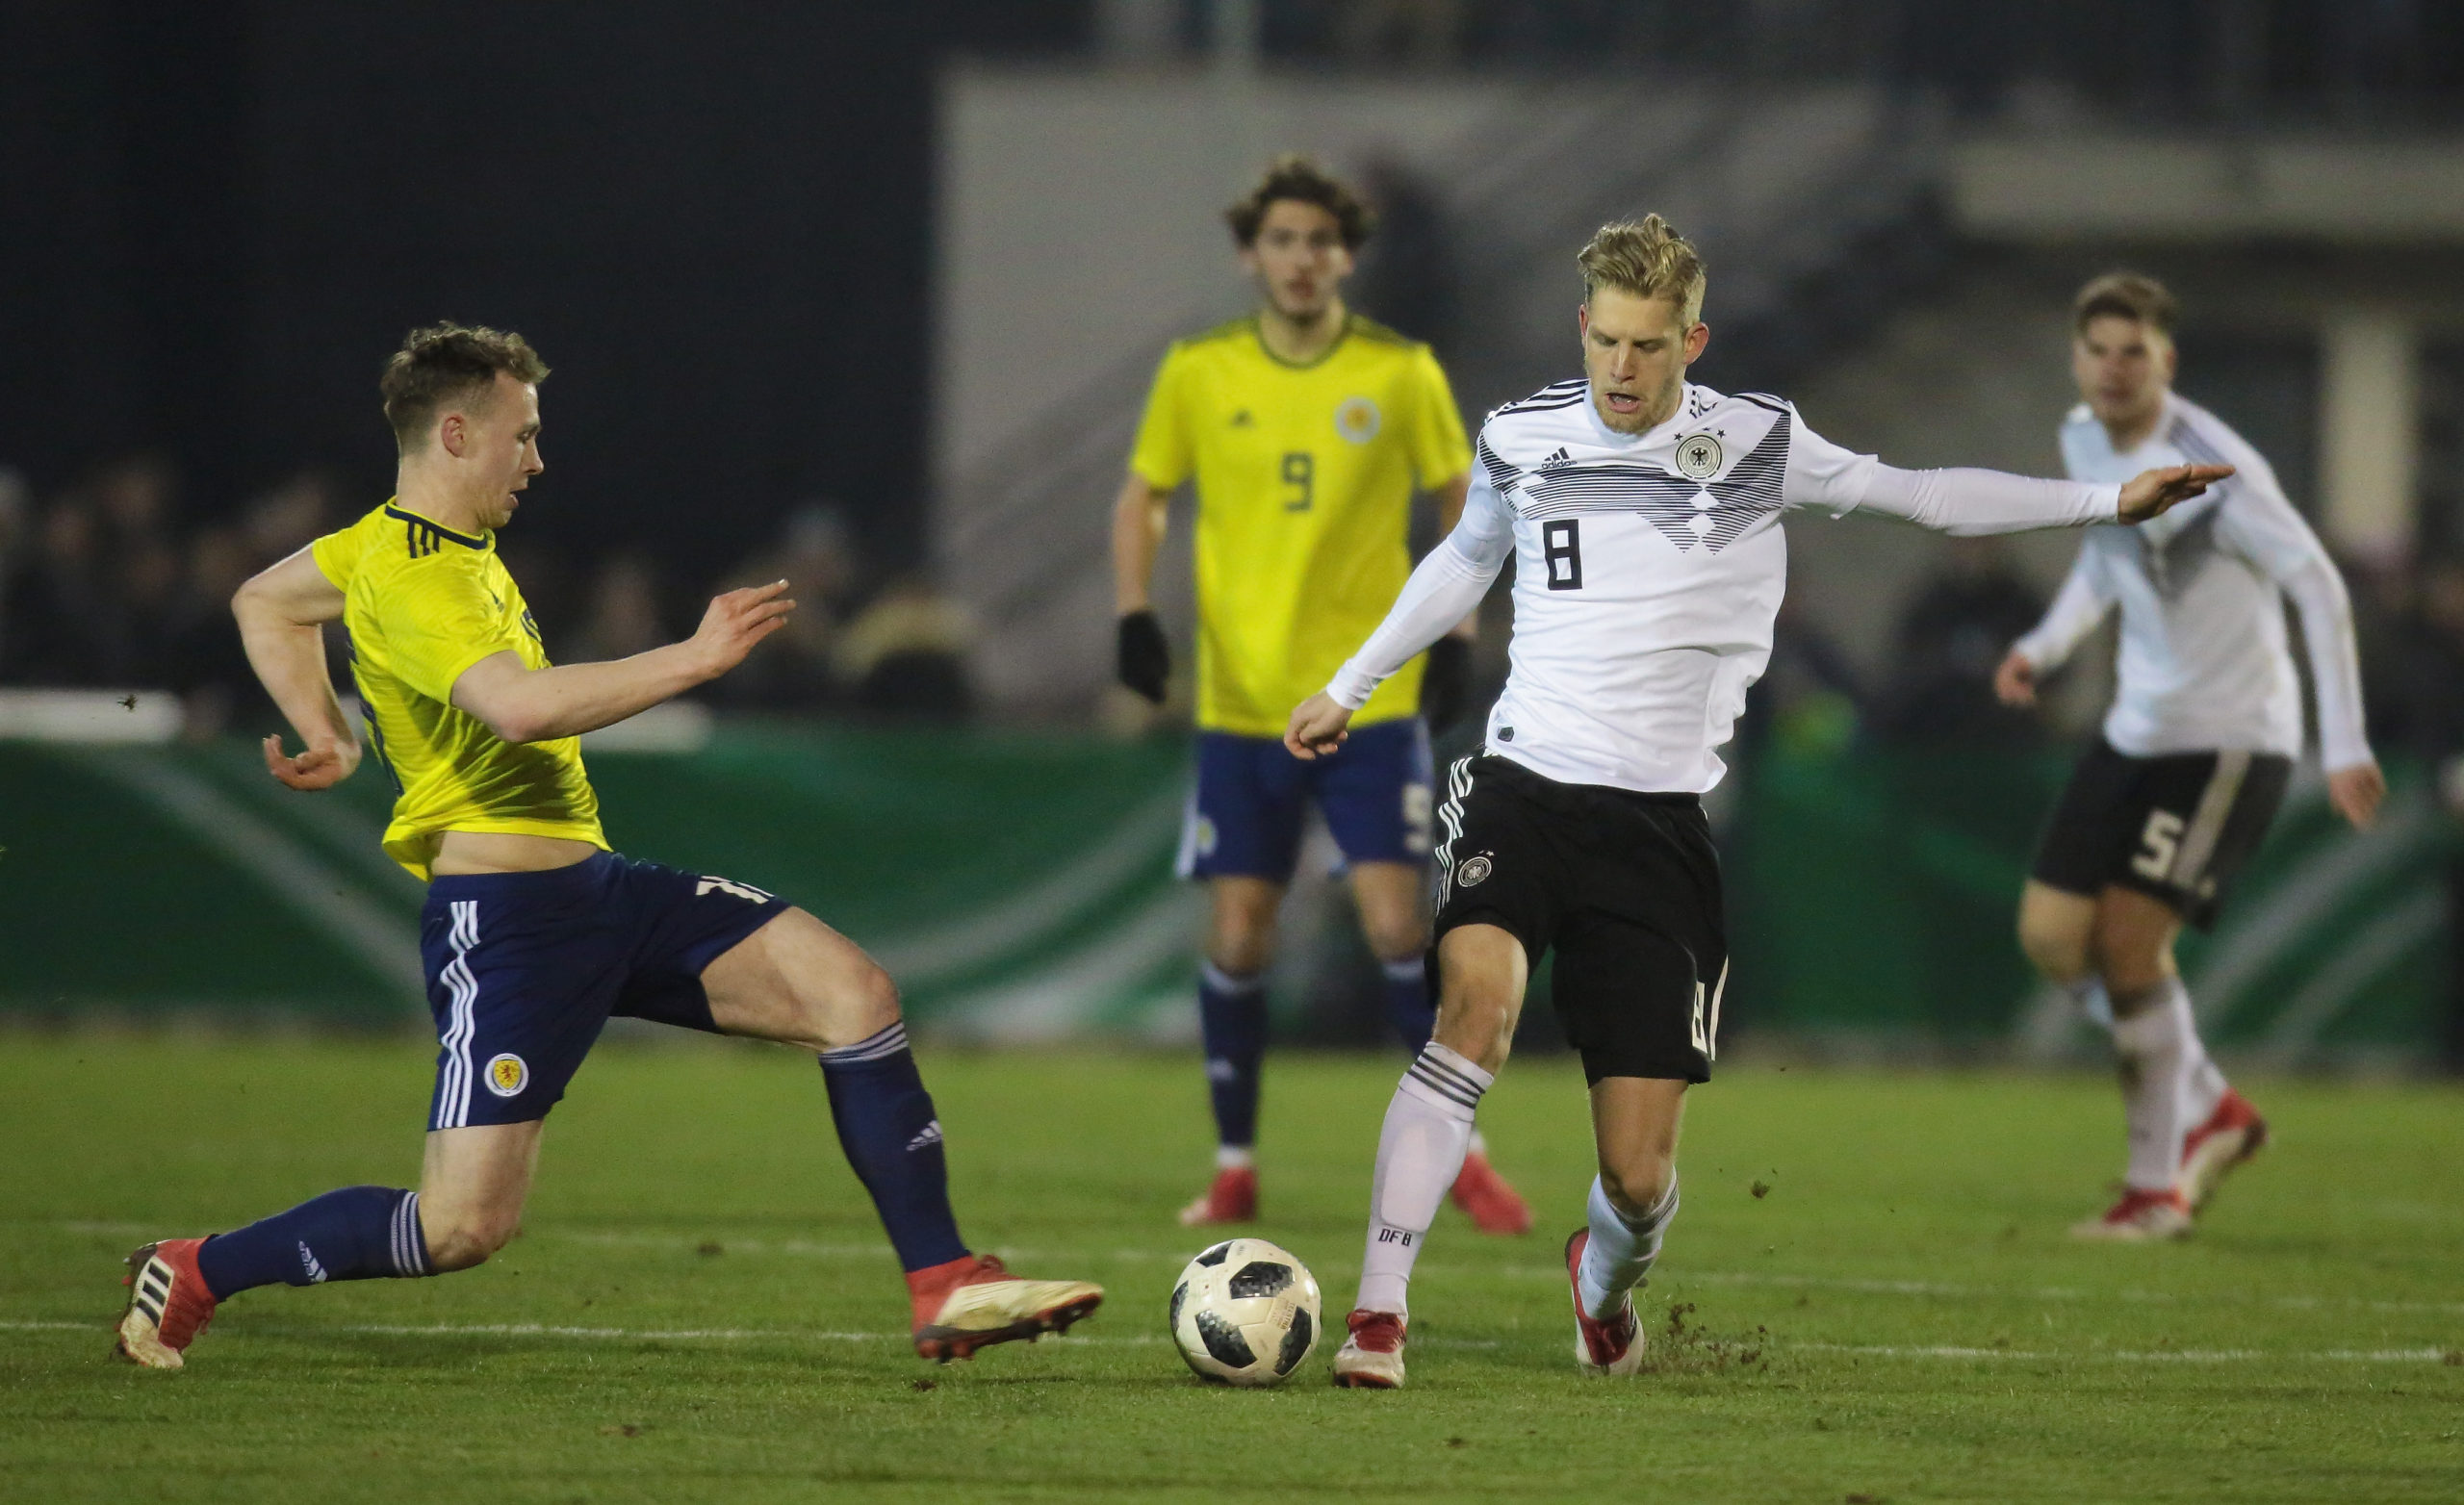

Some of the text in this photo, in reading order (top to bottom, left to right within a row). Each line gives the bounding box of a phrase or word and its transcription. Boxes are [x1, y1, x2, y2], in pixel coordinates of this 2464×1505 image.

[1281, 451, 1314, 512] 9
[1543, 518, 1583, 591] 8
[2131, 809, 2184, 880] 5
